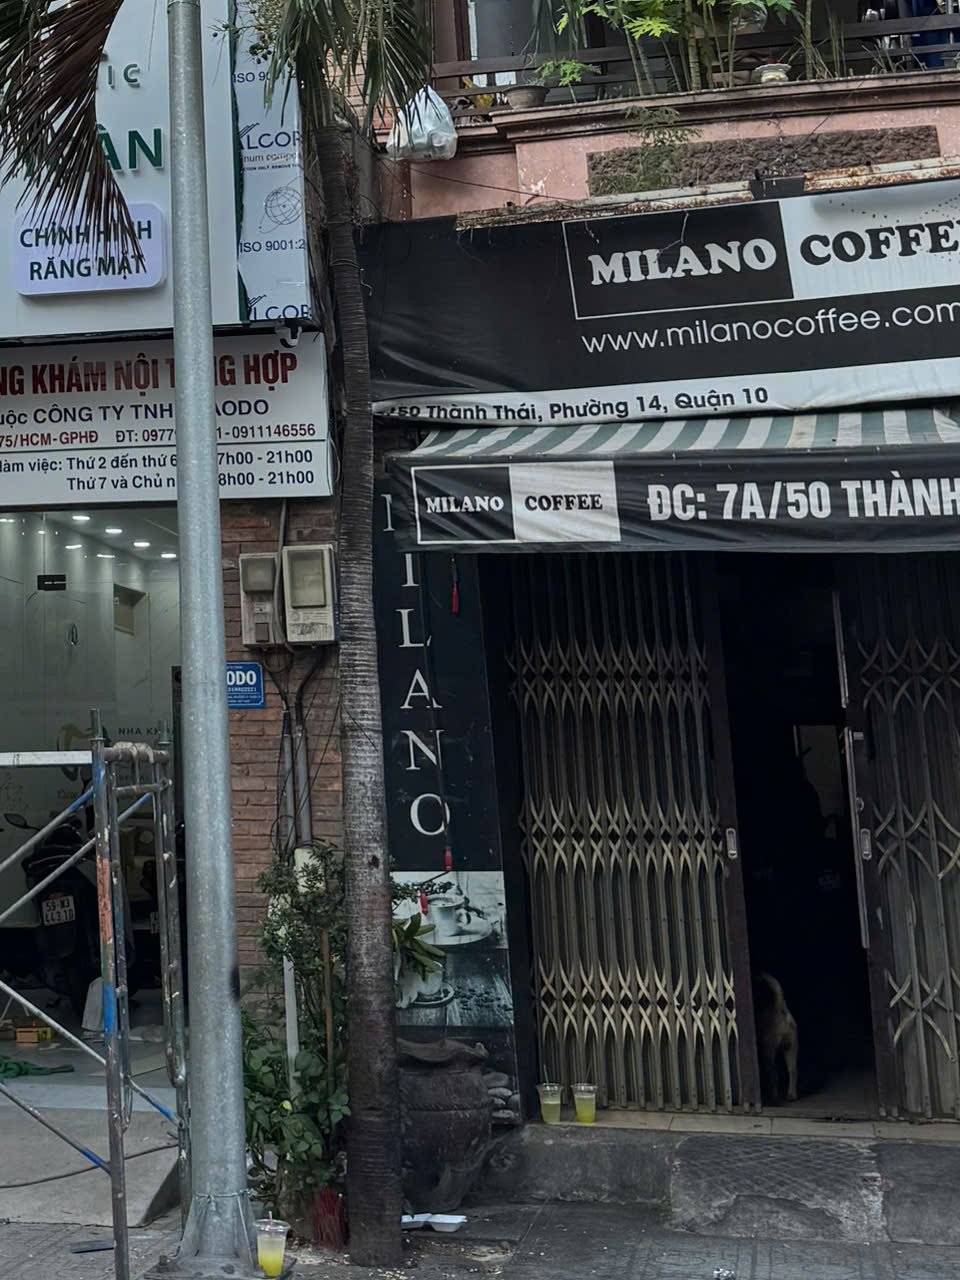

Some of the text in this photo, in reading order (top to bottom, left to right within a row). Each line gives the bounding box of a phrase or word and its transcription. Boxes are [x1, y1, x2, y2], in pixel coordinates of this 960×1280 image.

[586, 219, 960, 287] MILANO COFFE
[29, 256, 91, 281] RĂNG
[580, 301, 960, 355] www.milanocoffee.com
[31, 354, 107, 396] KHÁM
[114, 351, 160, 397] NỘI
[243, 349, 298, 392] HỢP
[32, 402, 94, 426] CÔNG
[98, 405, 125, 422] TY
[130, 403, 174, 421] TNH
[493, 403, 543, 423] Thái,
[549, 396, 629, 422] Phường
[636, 394, 668, 415] 14,
[674, 390, 735, 411] Quận
[741, 386, 769, 405] 10
[115, 428, 139, 444] ĐT:
[28, 455, 63, 473] việc:
[66, 454, 96, 471] Thứ
[97, 456, 107, 471] 2
[110, 451, 139, 469] đến
[140, 452, 167, 468] thứ
[216, 450, 254, 467] 7h00
[266, 448, 313, 465] 21h00
[66, 474, 96, 491] Thứ
[98, 476, 107, 491] 7
[109, 473, 129, 489] và
[132, 470, 164, 489] Chủ
[217, 471, 255, 487] 8h00
[267, 469, 315, 486] 21h00
[424, 493, 603, 515] MILANO COFFEE
[646, 470, 960, 522] ĐC: 7A/50 THÀNH
